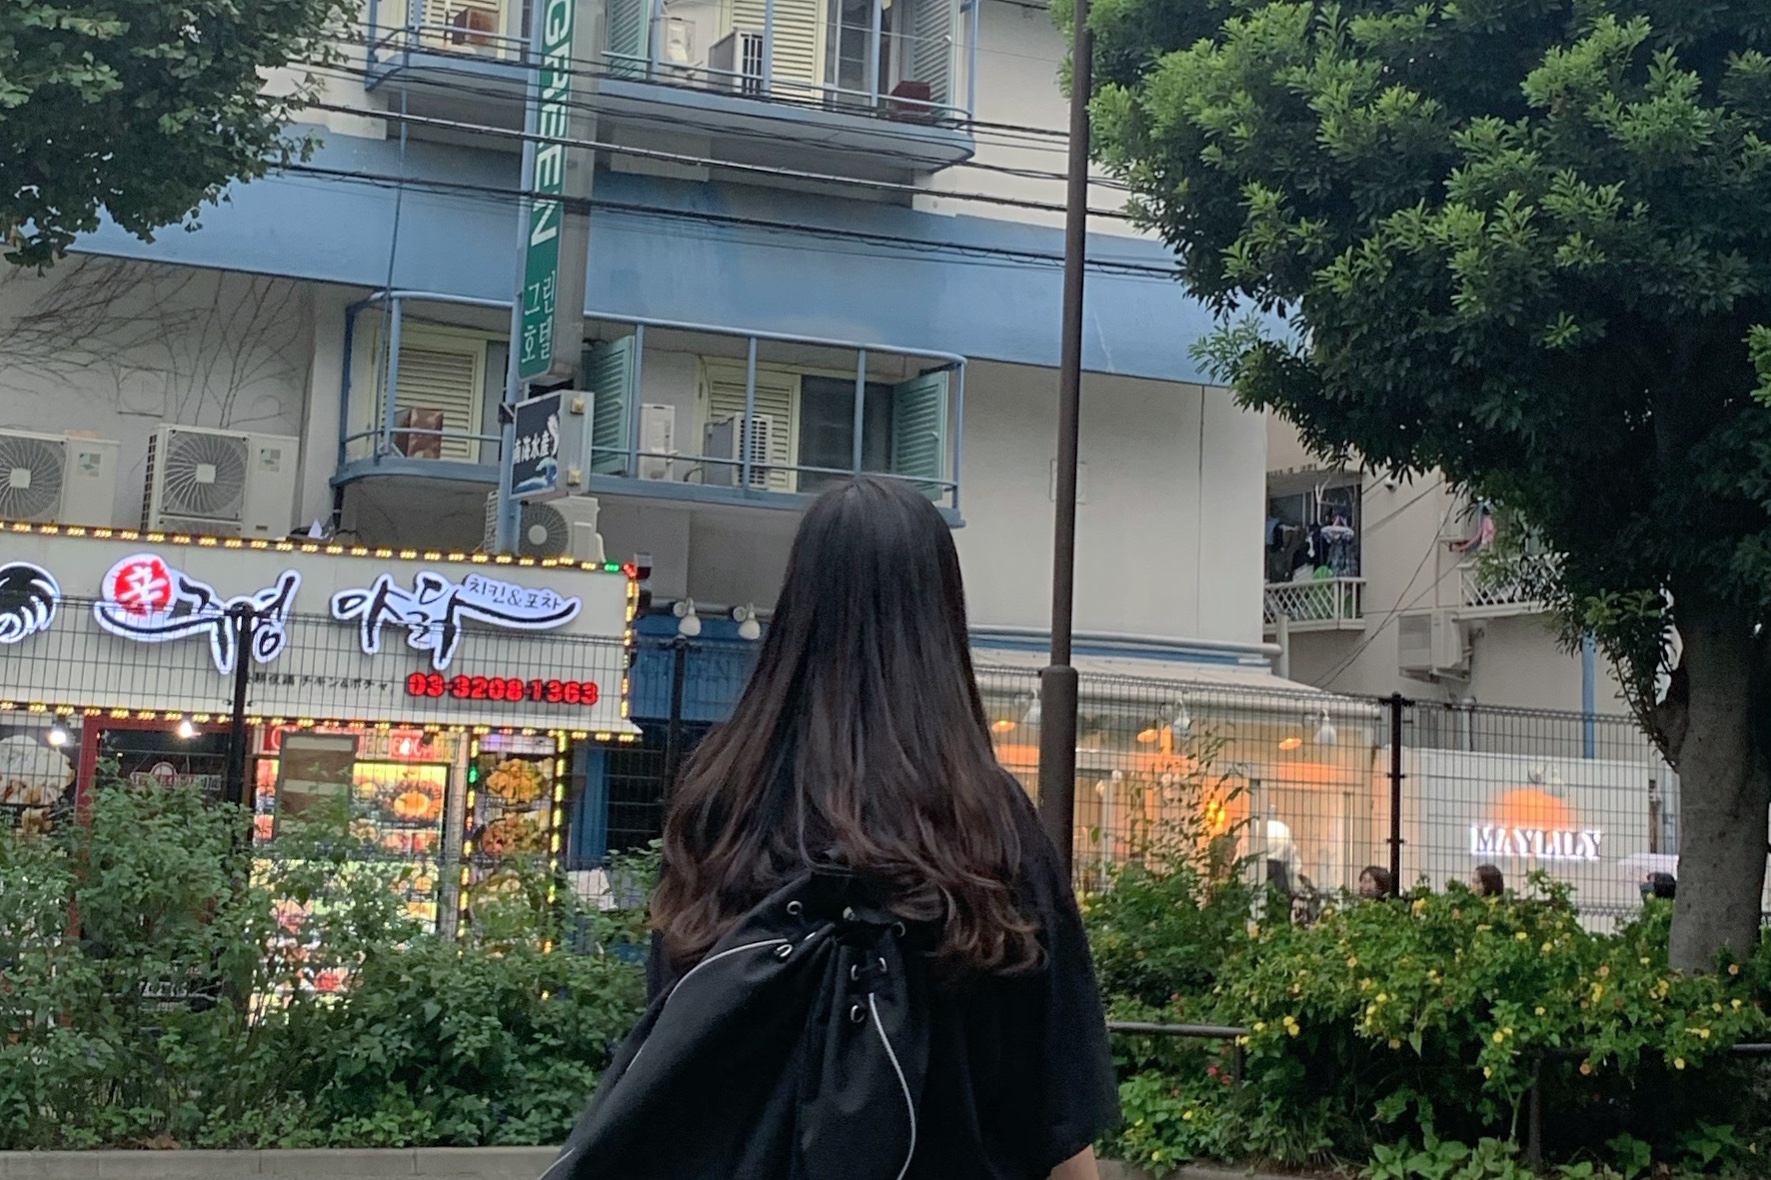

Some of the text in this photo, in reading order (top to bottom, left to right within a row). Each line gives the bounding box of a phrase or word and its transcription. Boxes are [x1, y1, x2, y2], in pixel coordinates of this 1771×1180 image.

[531, 0, 571, 247] GREEN
[524, 270, 555, 315] 그린
[521, 315, 552, 363] 호텔
[468, 576, 563, 612] 치킨&포차
[408, 672, 598, 705] 03-3208-1363
[1472, 826, 1605, 859] MAYLILY
